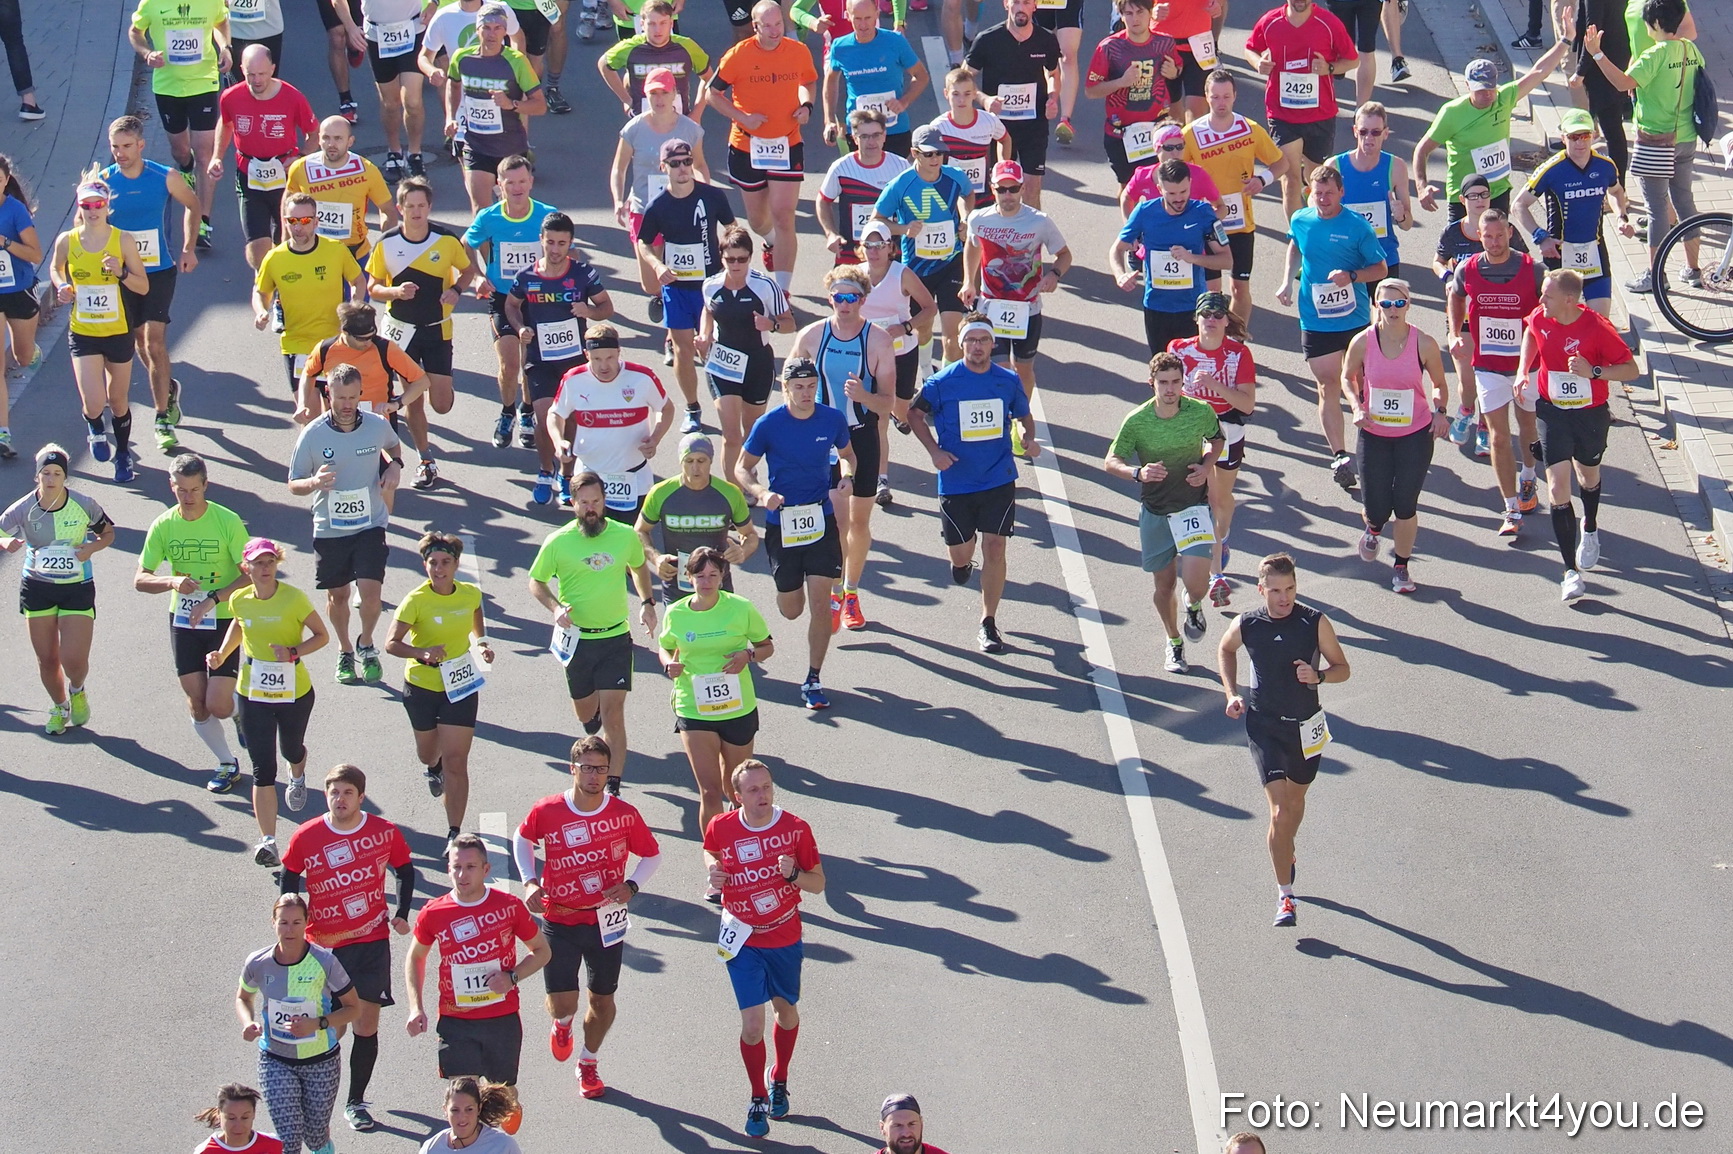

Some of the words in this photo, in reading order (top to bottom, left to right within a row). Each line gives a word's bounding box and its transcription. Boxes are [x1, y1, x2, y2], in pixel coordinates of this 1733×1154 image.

[384, 29, 410, 43] 2514
[172, 38, 198, 52] 2290
[778, 73, 798, 81] POLES
[848, 66, 887, 76] www.hasit.de
[1285, 82, 1312, 94] 2429
[1004, 94, 1030, 105] 2354
[470, 108, 494, 120] 2525
[863, 104, 890, 112] 261
[1132, 132, 1151, 144] 127
[756, 144, 784, 154] 3129
[1200, 150, 1225, 160] MAX
[1228, 138, 1254, 153] BÖGL
[1480, 150, 1505, 168] 3070
[256, 168, 276, 178] 339
[310, 182, 335, 194] MAX
[340, 176, 368, 188] BÖGL
[1564, 186, 1604, 200] BOCK
[318, 210, 344, 224] 2421
[978, 225, 1016, 236] FINISHER
[700, 218, 712, 265] RAILONE
[926, 233, 946, 244] 173
[506, 252, 536, 264] 2115
[674, 254, 694, 265] 249
[1575, 252, 1587, 263] 38
[1164, 262, 1179, 274] 43
[86, 296, 108, 307] 142
[528, 292, 582, 304] MENSCH
[1319, 289, 1348, 304] 2479
[1000, 312, 1014, 324] 42
[385, 324, 403, 342] 245
[544, 330, 573, 345] 3066
[1486, 328, 1515, 340] 3060
[714, 348, 741, 367] 3062
[1562, 383, 1577, 394] 96
[1384, 398, 1398, 410] 95
[971, 411, 993, 424] 319
[604, 482, 631, 496] 2320
[335, 501, 364, 514] 2263
[664, 514, 726, 528] BOCK
[792, 516, 814, 530] 130
[1183, 518, 1199, 532] 76
[42, 558, 74, 570] 2235
[260, 673, 284, 686] 294
[450, 664, 474, 684] 2552
[705, 684, 730, 698] 153
[309, 865, 375, 894] aumbox
[605, 908, 628, 927] 222
[442, 938, 499, 966] umbox
[464, 975, 489, 989] 112
